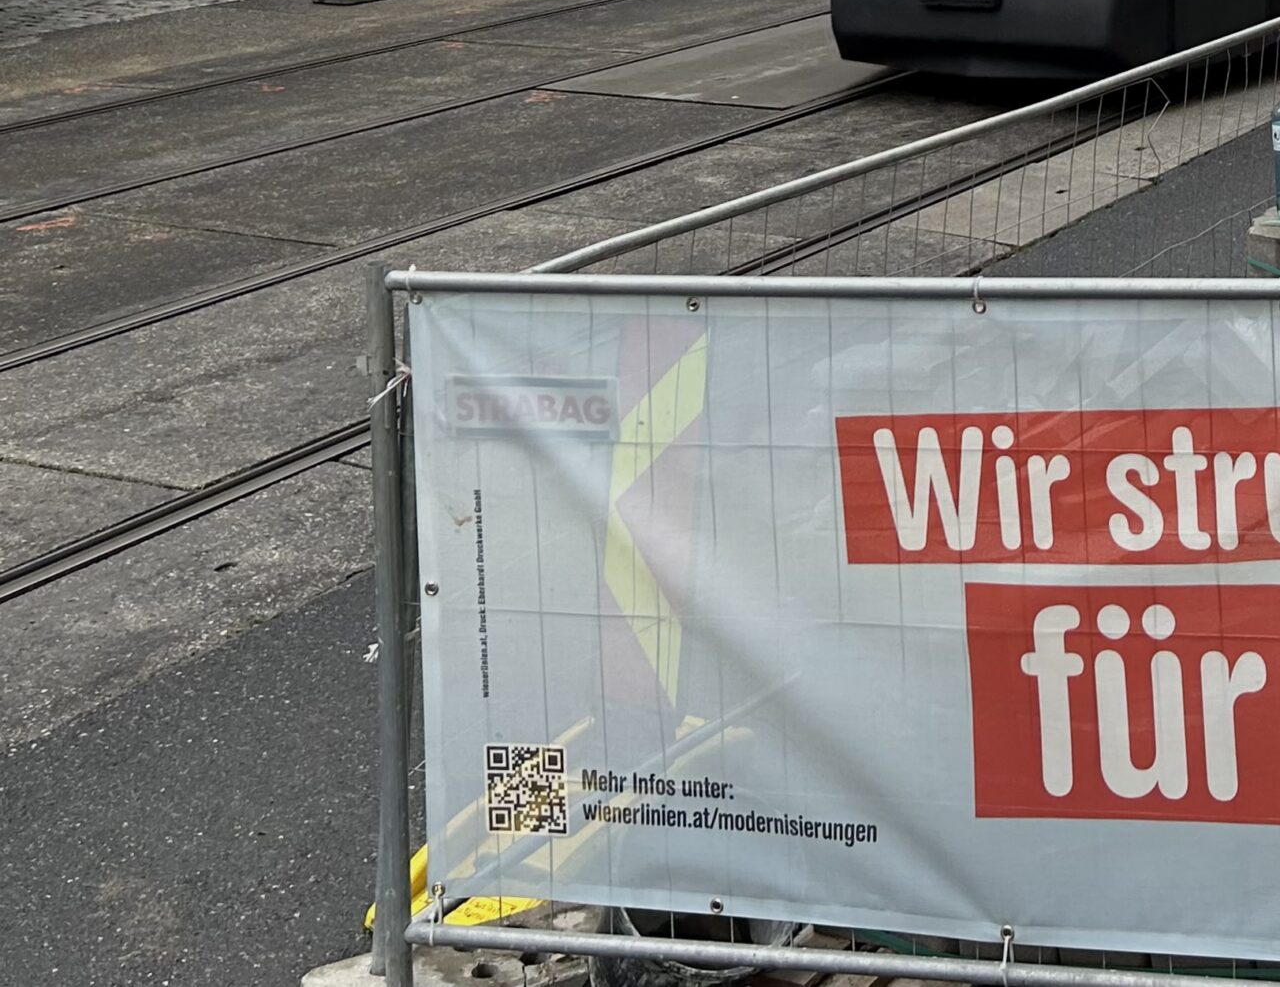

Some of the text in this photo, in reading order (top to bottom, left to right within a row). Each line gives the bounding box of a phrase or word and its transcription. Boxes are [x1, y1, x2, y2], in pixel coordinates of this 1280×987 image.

[455, 392, 611, 425] STRABAG
[873, 425, 1070, 551] Wir
[1020, 604, 1267, 802] für
[582, 769, 734, 800] Mehr Infos unter:
[583, 800, 878, 847] wienerlinien.at/modernisierungen
